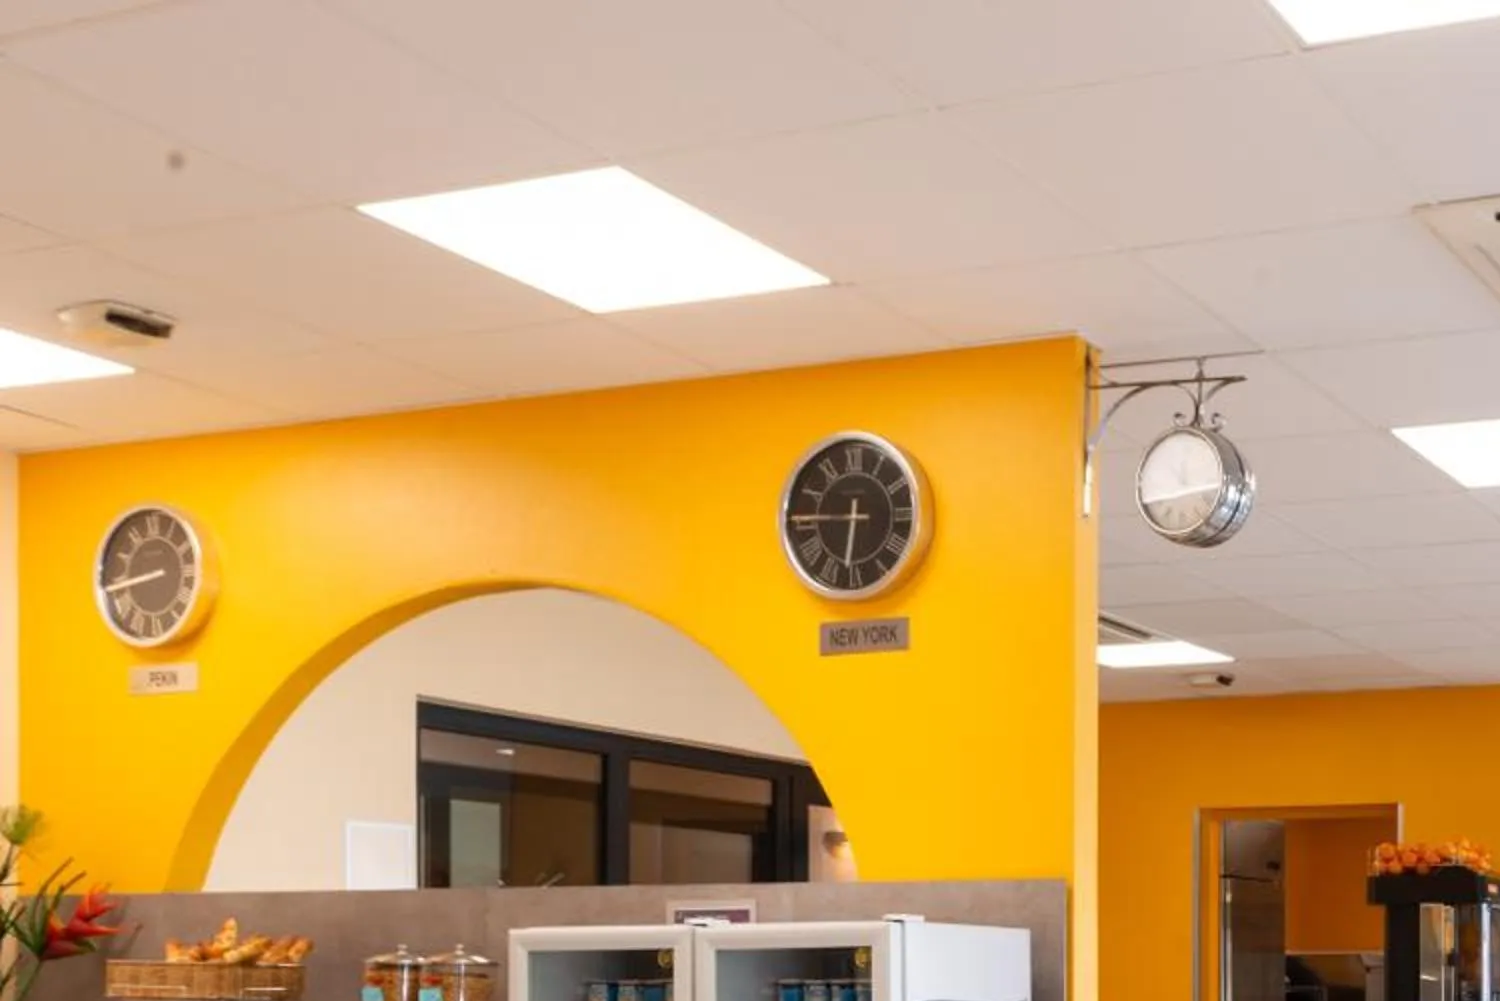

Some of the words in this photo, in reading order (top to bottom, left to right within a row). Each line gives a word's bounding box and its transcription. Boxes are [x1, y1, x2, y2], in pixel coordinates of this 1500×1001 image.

[829, 626, 859, 647] NEW
[861, 624, 898, 646] YORK
[148, 671, 178, 688] PEKIN
